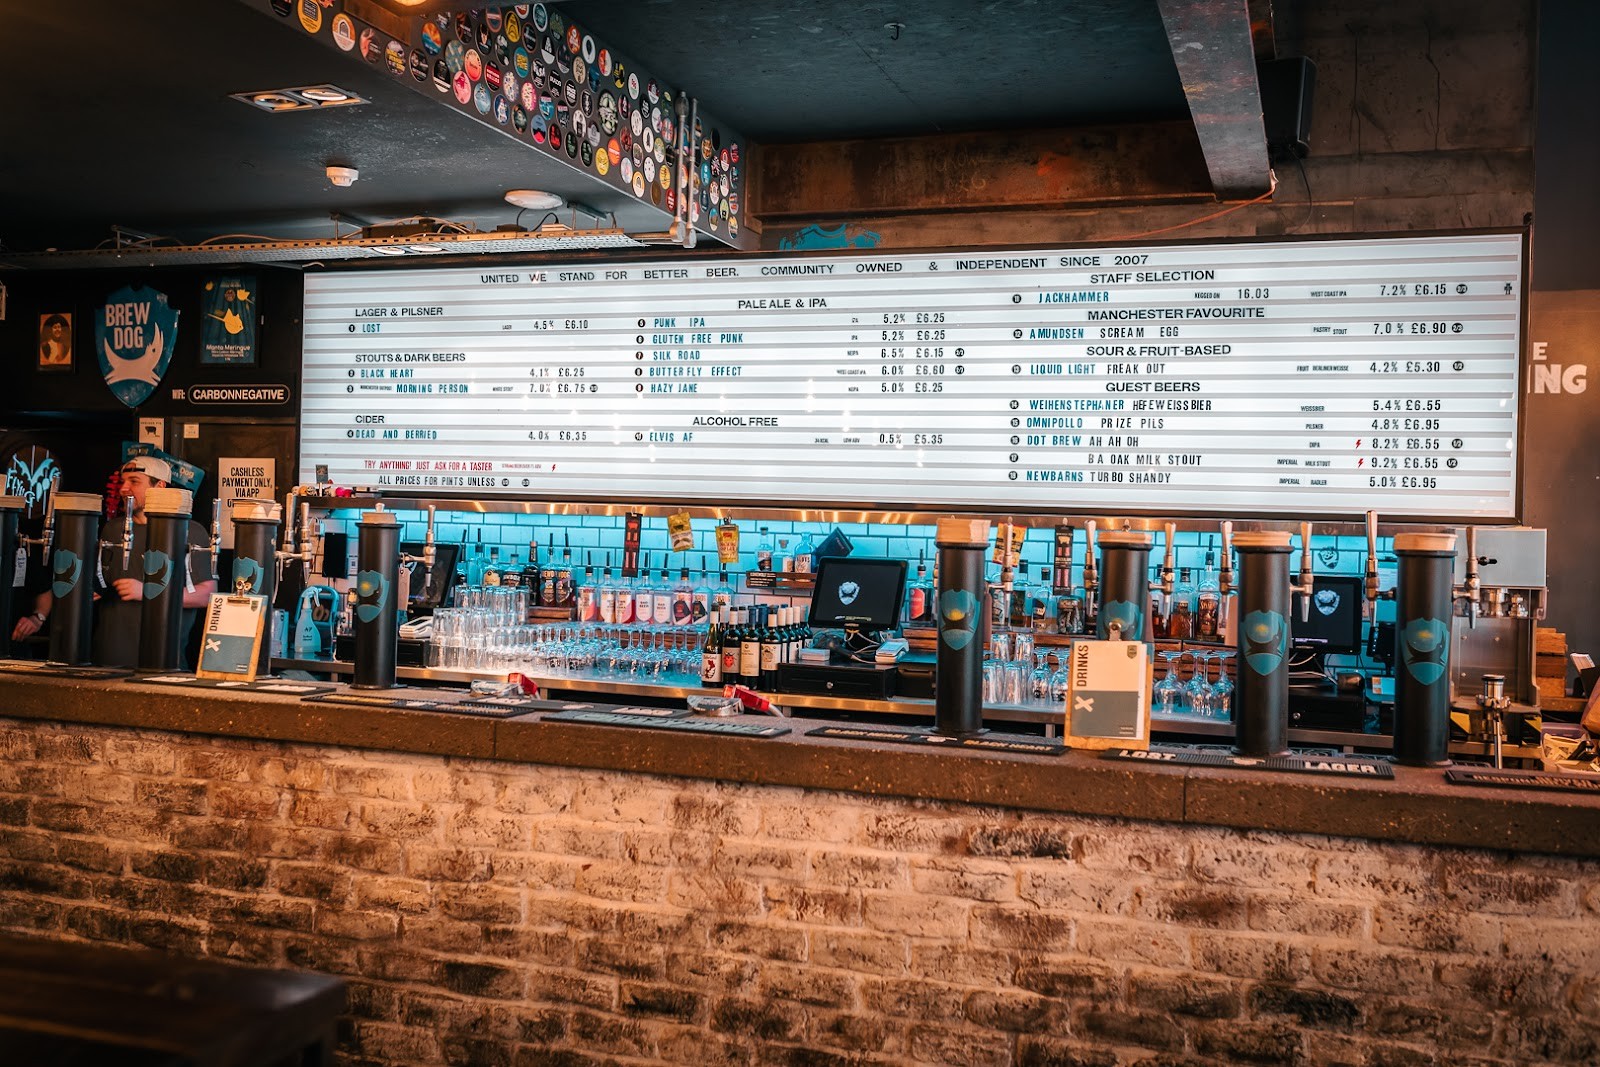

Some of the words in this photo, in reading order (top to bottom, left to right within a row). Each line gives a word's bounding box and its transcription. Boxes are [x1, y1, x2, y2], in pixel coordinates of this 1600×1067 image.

[481, 274, 520, 284] UNITED
[529, 273, 547, 282] WE
[560, 272, 595, 282] STAND
[606, 271, 628, 280] FOR
[644, 270, 688, 278] BETTER
[706, 268, 739, 277] BEER.
[761, 265, 834, 276] COMMUNITY
[856, 263, 902, 273] OWNED
[928, 262, 938, 271] &
[956, 258, 1047, 270] INDEPENDENT
[1060, 256, 1100, 266] SINCE
[1115, 255, 1149, 266] 2007
[1090, 273, 1132, 284] STAFF
[1136, 270, 1214, 282] SELECTION
[1039, 292, 1109, 304] JACKHAMMER
[1238, 288, 1269, 299] 16.03
[1380, 284, 1406, 296] 7.2%
[1415, 284, 1446, 296] £6.15
[738, 300, 767, 309] PALE
[770, 300, 791, 308] ALE
[796, 299, 804, 308] &
[809, 298, 827, 308] IPA
[105, 302, 150, 327] BREW
[355, 308, 387, 316] LAGER
[390, 308, 398, 316] &
[402, 307, 443, 316] PILSNER
[1088, 308, 1183, 320] MANCHESTER
[1186, 307, 1264, 318] FAVOURITE
[362, 324, 380, 332] LOST
[565, 320, 588, 329] £6.10
[654, 318, 676, 328] PUNK
[690, 318, 705, 327] IPA
[884, 314, 906, 324] 5.2%
[916, 313, 944, 323] £6.25
[1030, 328, 1084, 338] AMUNDSEN
[1100, 328, 1144, 338] SCREAM
[1160, 326, 1179, 337] EGG
[1411, 322, 1446, 334] £6.90
[114, 326, 144, 350] DOG
[653, 334, 684, 344] GLUTEN
[692, 334, 712, 344] FREE
[720, 334, 744, 343] PUNK
[882, 331, 904, 341] 5.2%
[917, 330, 945, 340] £6.25
[654, 350, 671, 360] SILK
[678, 350, 700, 360] ROAD
[882, 348, 904, 358] 6.5%
[916, 348, 944, 358] £6.15
[1087, 346, 1124, 356] SOUR
[1126, 346, 1136, 356] &
[1140, 344, 1232, 356] FRUIT-BASED
[355, 354, 395, 362] STOUTS
[396, 354, 402, 362] &
[404, 353, 431, 362] DARK
[432, 353, 466, 362] BEERS
[361, 370, 384, 378] BLACK
[390, 369, 414, 378] HEART
[530, 368, 549, 378] 4.1%
[558, 368, 584, 377] £6.25
[650, 367, 702, 376] BUTTERFLY
[712, 367, 742, 376] EFFECT
[882, 366, 904, 376] 6.0%
[916, 365, 944, 376] £6.60
[1030, 364, 1062, 375] LIQUID
[1068, 364, 1096, 374] LIGHT
[1107, 364, 1139, 374] FREAK
[1146, 363, 1165, 374] OUT
[1370, 362, 1398, 372] 4.2%
[1406, 362, 1440, 372] £5.30
[396, 384, 432, 393] MORNING
[439, 384, 468, 393] PERSON
[558, 384, 585, 392] £6.75
[651, 384, 673, 392] HAZY
[678, 384, 698, 392] JANE
[882, 382, 904, 392] 5.0%
[915, 382, 942, 392] £6.25
[1106, 382, 1152, 392] GUEST
[1154, 382, 1200, 392] BEERS
[193, 389, 284, 400] CARBONNEGATIVE
[1030, 400, 1124, 410] WEIHENSTEPHANER
[1373, 400, 1401, 410] 5.4%
[1406, 400, 1441, 410] £6.55
[356, 415, 384, 424] CIDER
[693, 416, 746, 426] ALCOHOL
[749, 417, 778, 426] FREE
[1027, 418, 1082, 428] OMNIPOLLO
[1101, 418, 1132, 428] PRIZE
[1141, 418, 1164, 428] PILS
[1372, 420, 1399, 430] 4.8%
[1404, 419, 1440, 430] £6.95
[356, 430, 374, 438] DEAD
[383, 430, 398, 438] AND
[406, 430, 437, 439] BERRIED
[528, 432, 549, 441] 4.0%
[560, 432, 586, 440] £6.35
[650, 432, 674, 442] ELVIS
[683, 432, 693, 442] AF
[880, 434, 901, 444] 0.5%
[914, 434, 942, 444] £5.35
[1028, 436, 1046, 446] DOT
[1052, 436, 1082, 446] BREW
[1090, 436, 1102, 446] AH
[1108, 436, 1121, 446] AH
[1127, 436, 1138, 446] OH
[1372, 438, 1398, 449] 8.2%
[1406, 438, 1440, 450] £6.55
[364, 460, 376, 469] TRY
[380, 460, 412, 470] ANYTHING!
[416, 461, 430, 470] JUST
[434, 462, 447, 470] ASK
[448, 462, 460, 470] FOR
[462, 462, 466, 470] A
[470, 462, 492, 471] TASTER
[1110, 454, 1130, 464] OAK
[1136, 454, 1160, 465] MILK
[1168, 454, 1202, 466] STOUT
[1372, 458, 1398, 468] 9.2%
[1404, 458, 1438, 468] £6.55
[231, 467, 264, 476] CASHLESS
[222, 478, 254, 487] PAYMENT
[254, 478, 272, 488] ONLY,
[379, 476, 392, 484] ALL
[396, 476, 420, 486] PRICES
[424, 476, 438, 486] FOR
[442, 477, 463, 486] PINTS
[468, 478, 496, 486] UNLESS
[1027, 471, 1082, 482] NEWBARNS
[1090, 472, 1123, 482] TURBO
[1130, 472, 1171, 483] SHANDY
[1370, 476, 1396, 487] 5.0%
[1402, 477, 1436, 488] £6.95
[236, 488, 246, 498] VIA
[247, 488, 260, 498] APP
[210, 598, 223, 632] DRINKS
[1077, 645, 1088, 686] DRINKS
[1119, 750, 1176, 760] LOST
[1304, 761, 1377, 774] LAGER
